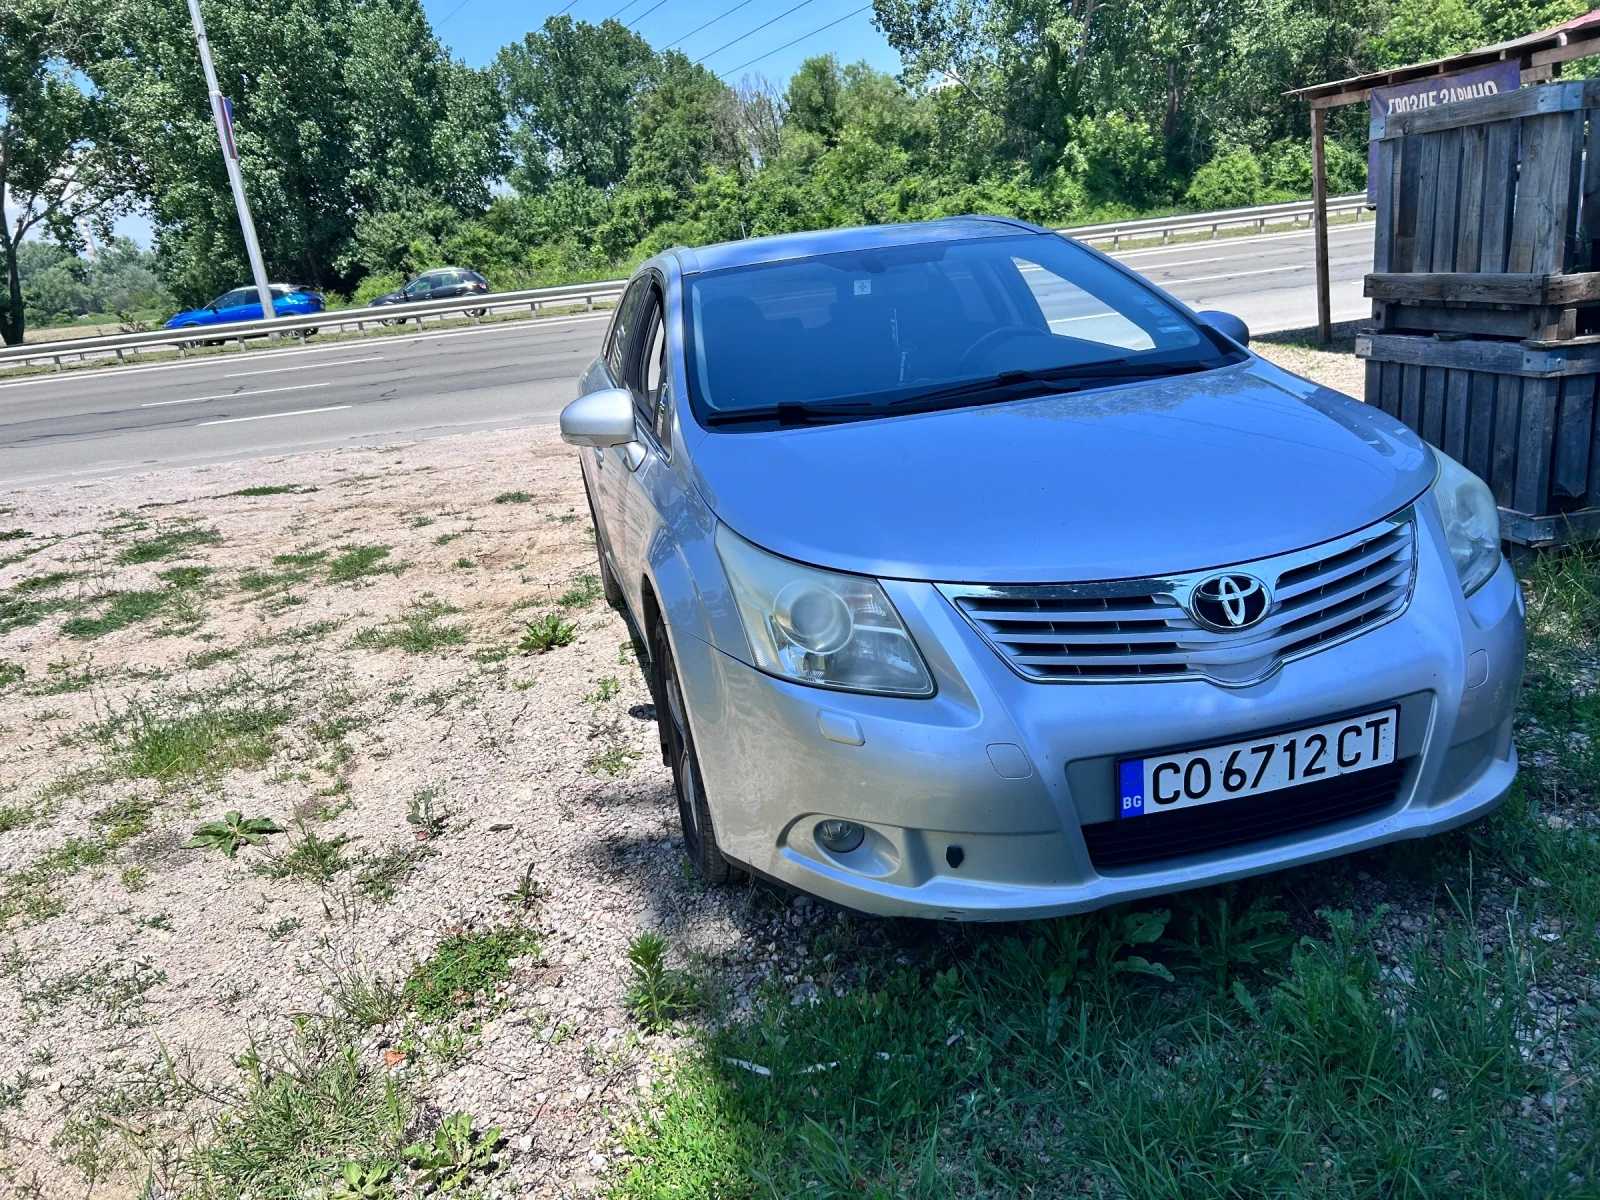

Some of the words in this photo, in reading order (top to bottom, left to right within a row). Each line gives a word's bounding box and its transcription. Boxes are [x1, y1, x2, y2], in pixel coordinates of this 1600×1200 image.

[1152, 757, 1211, 805] CO
[1223, 733, 1327, 793] 6712
[1337, 717, 1389, 768] CT
[1122, 795, 1142, 810] BG
